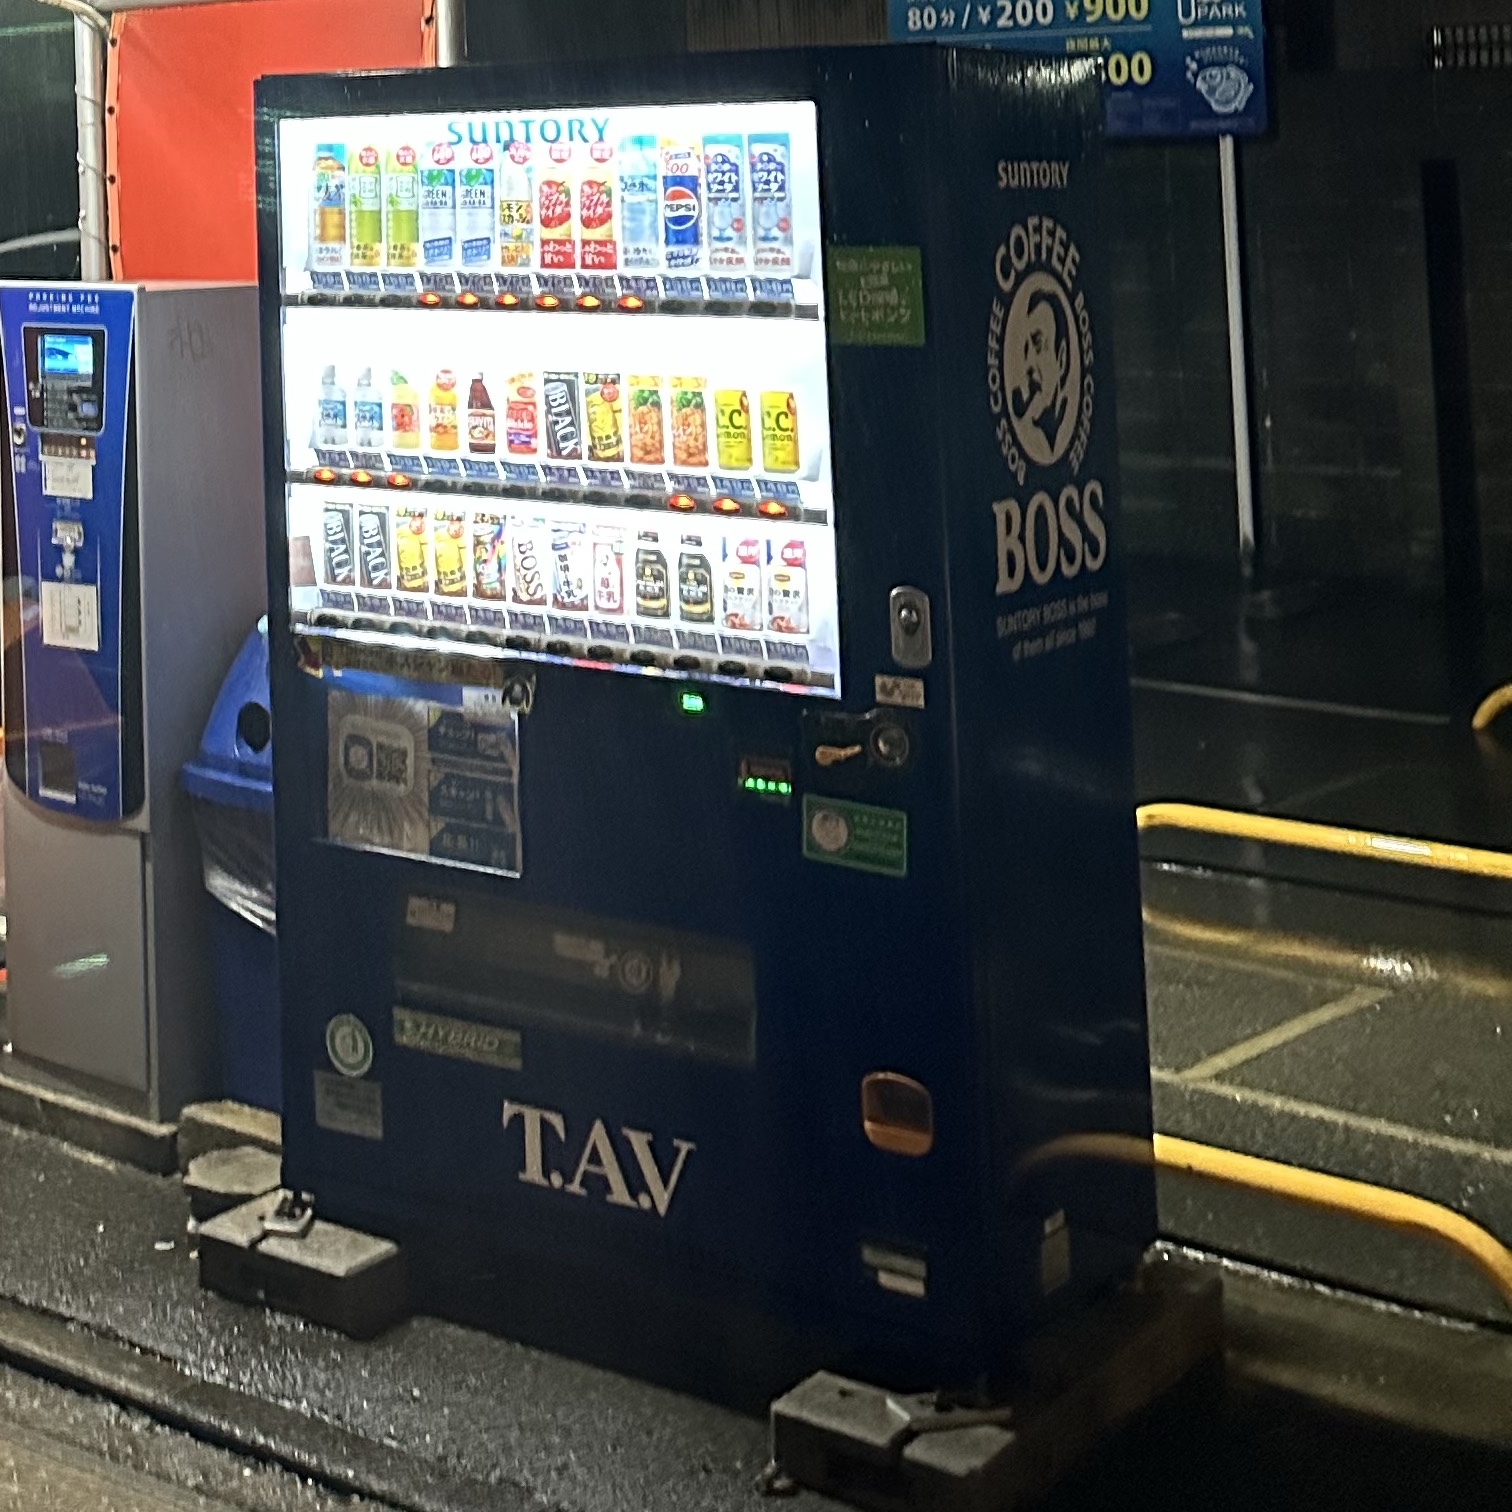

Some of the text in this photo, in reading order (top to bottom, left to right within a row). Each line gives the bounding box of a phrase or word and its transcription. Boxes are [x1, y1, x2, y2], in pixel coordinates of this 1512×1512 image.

[1197, 1, 1248, 21] PARK
[447, 117, 610, 145] SUNTORY
[997, 159, 1070, 188] SUNTORY
[995, 214, 1081, 293] COFFEE
[989, 297, 1006, 414] COFFEE
[548, 385, 576, 456] BLACK
[326, 519, 353, 583] BLACK
[361, 520, 388, 585] BLACK
[518, 540, 544, 597] BOSS
[992, 478, 1107, 596] BOSS
